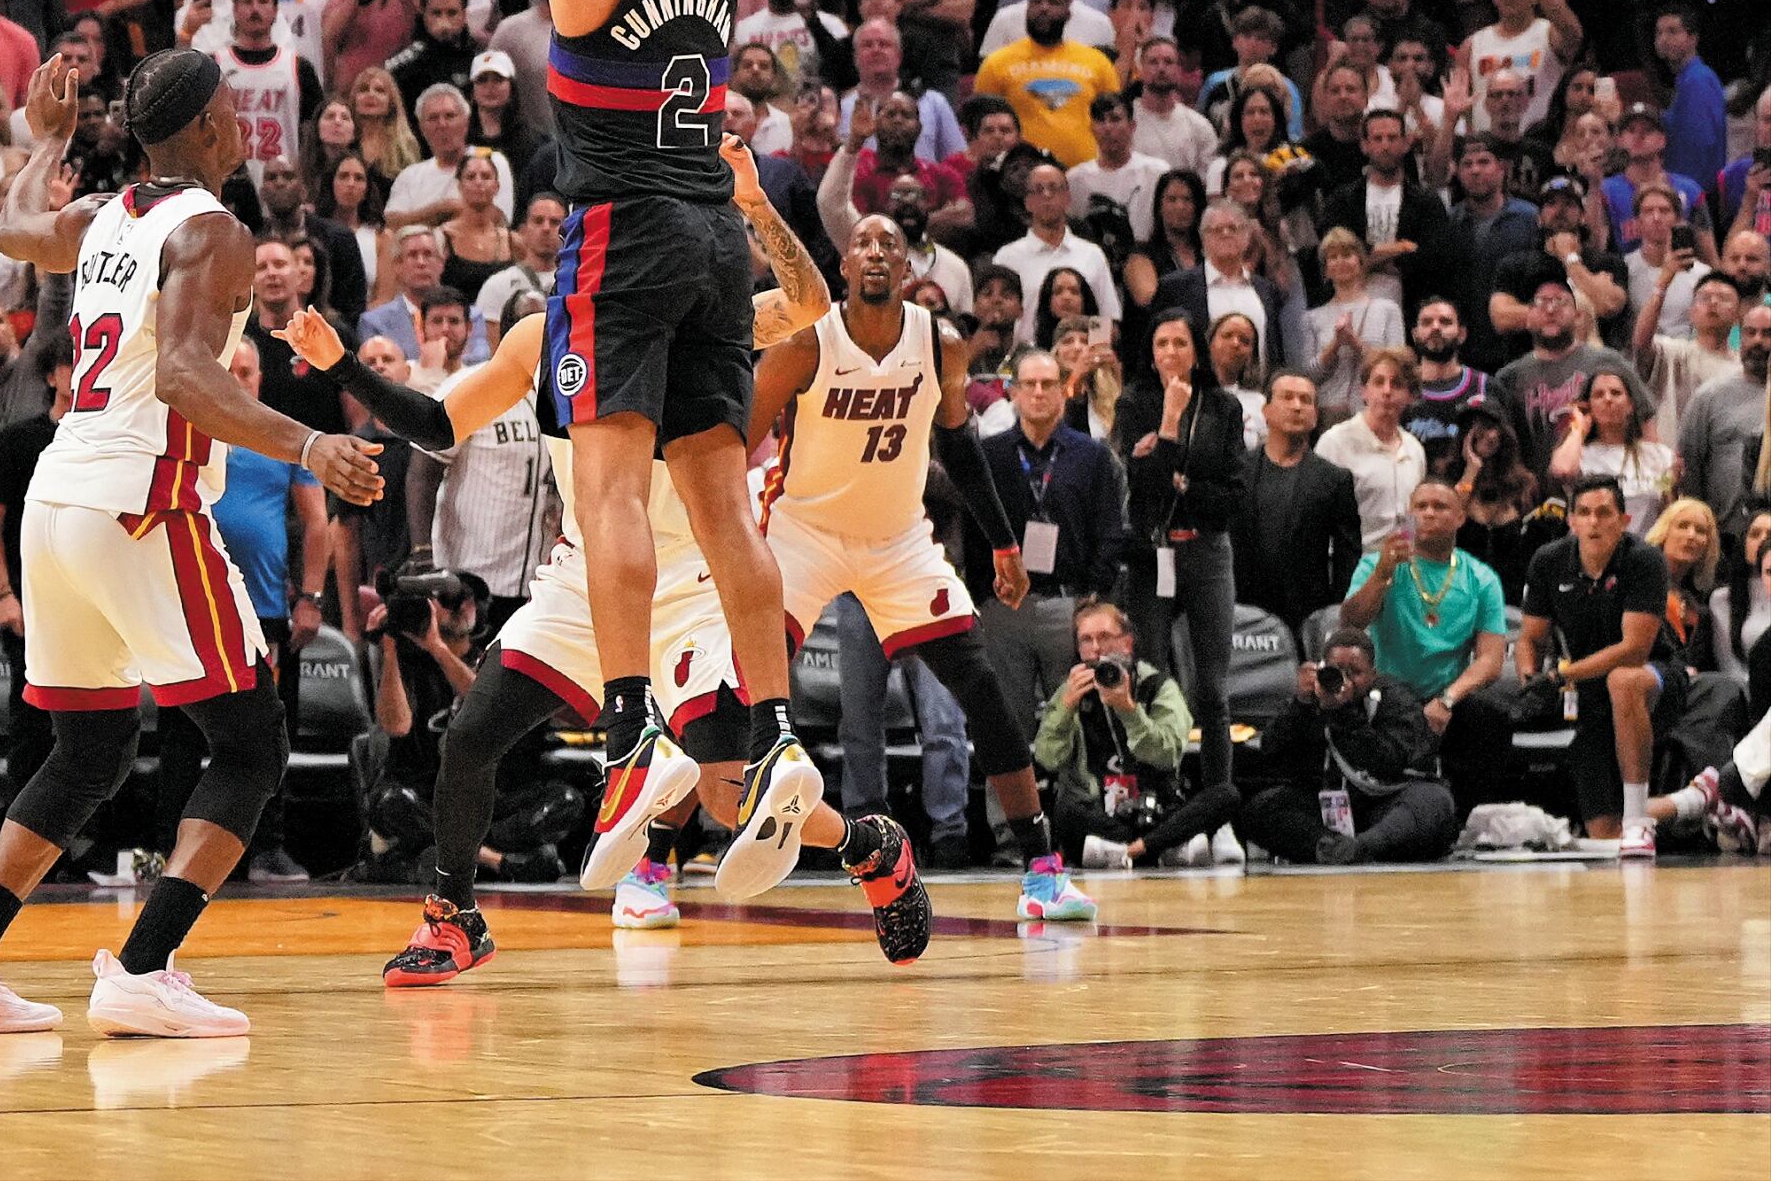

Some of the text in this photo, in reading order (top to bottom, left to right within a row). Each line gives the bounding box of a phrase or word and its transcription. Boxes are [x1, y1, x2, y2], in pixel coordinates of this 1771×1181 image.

[657, 54, 711, 150] 2
[68, 311, 125, 414] 2
[821, 372, 924, 421] HEAT
[860, 423, 909, 464] 13
